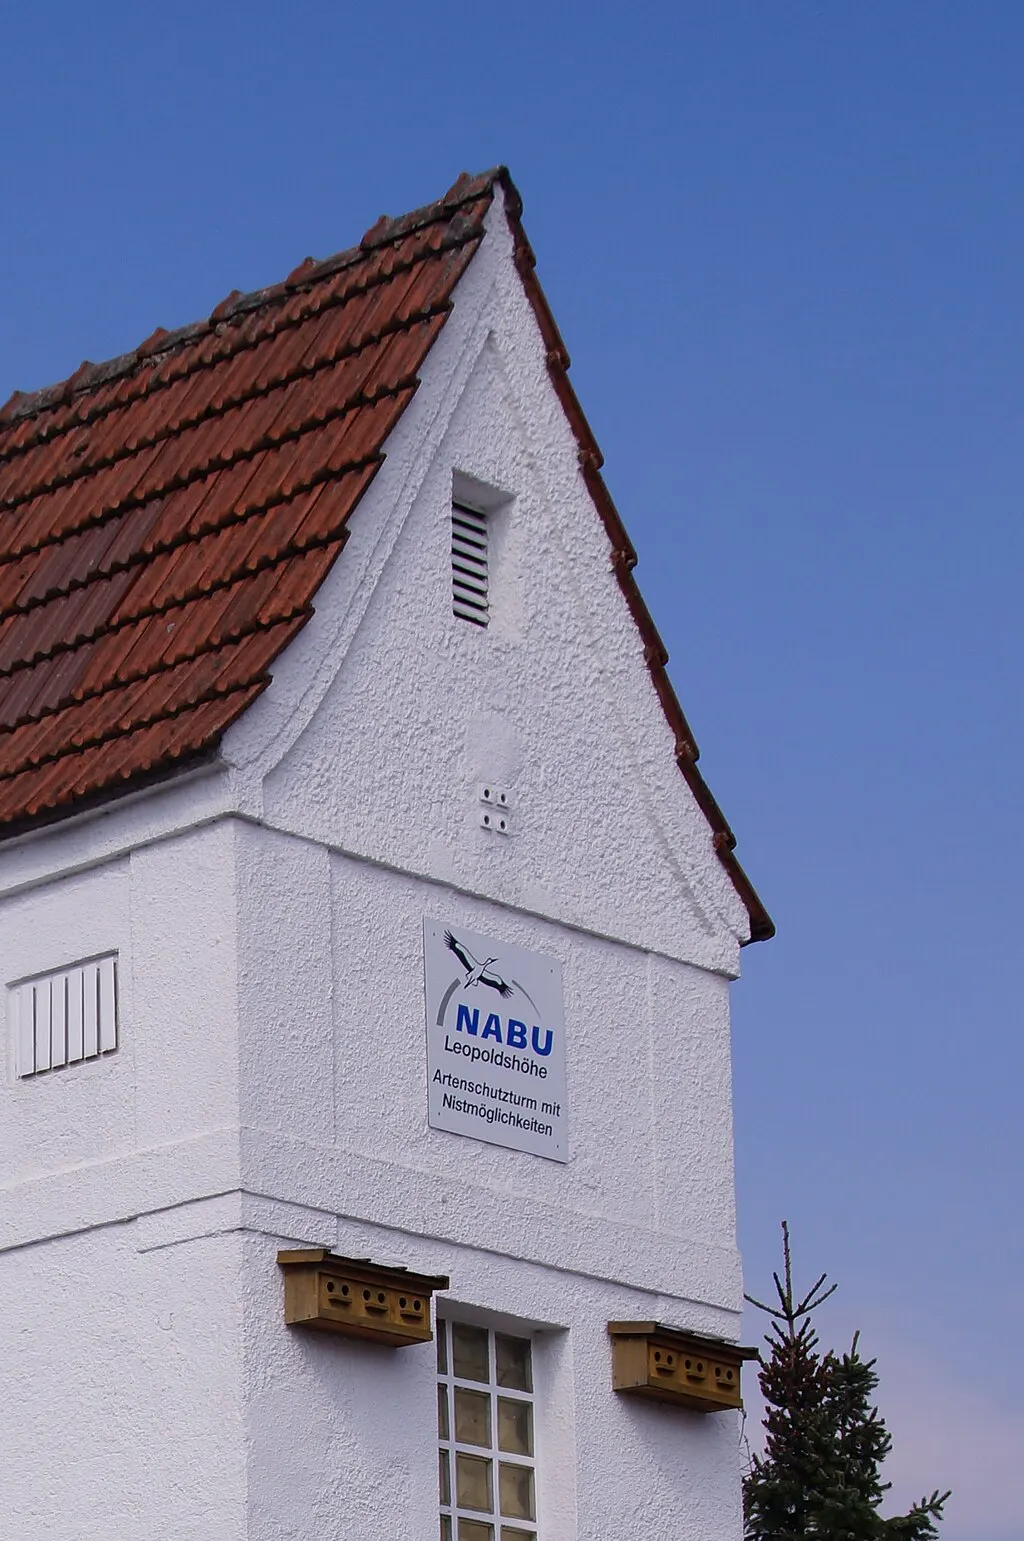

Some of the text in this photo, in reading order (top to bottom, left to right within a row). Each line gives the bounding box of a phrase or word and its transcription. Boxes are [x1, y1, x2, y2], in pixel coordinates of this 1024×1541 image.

[455, 1003, 554, 1057] NABU
[444, 1035, 548, 1079] Leopoldshöhe
[432, 1068, 561, 1117] Artenschutzturm mit
[442, 1093, 553, 1136] Nistmöglichkeiten
